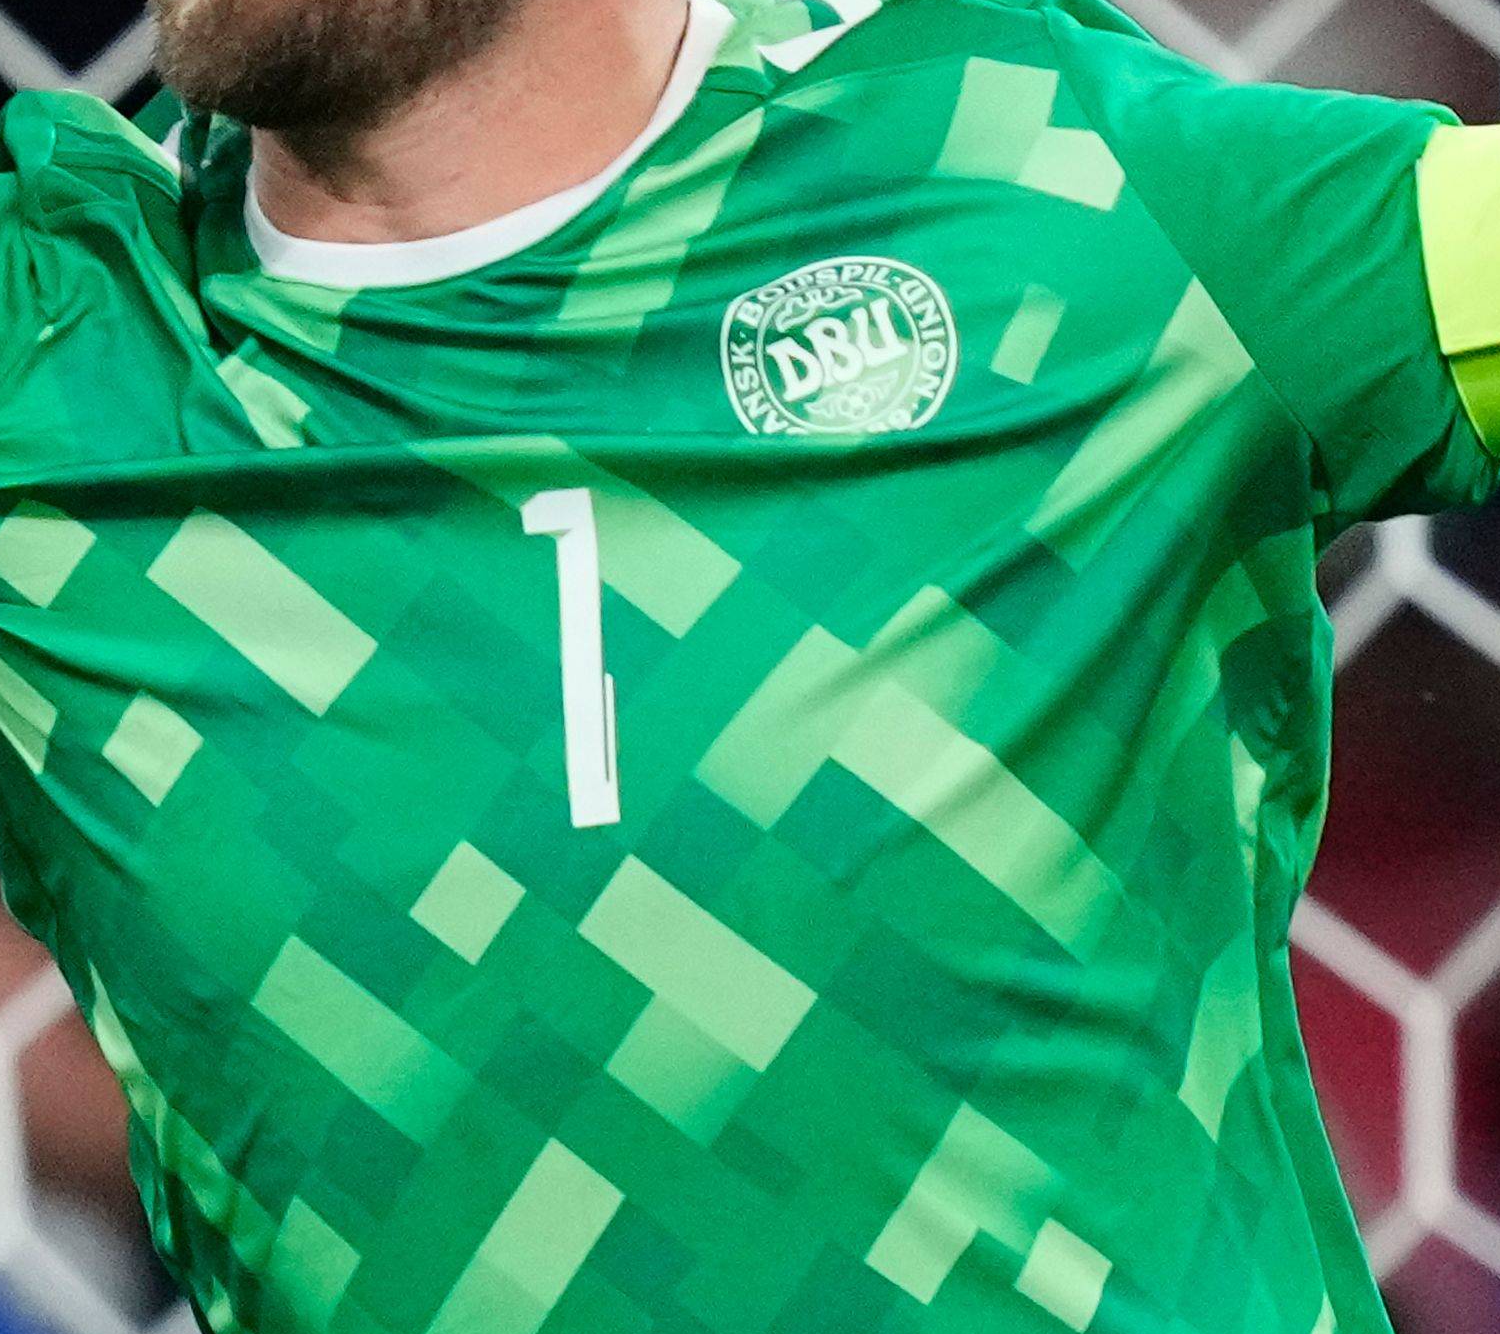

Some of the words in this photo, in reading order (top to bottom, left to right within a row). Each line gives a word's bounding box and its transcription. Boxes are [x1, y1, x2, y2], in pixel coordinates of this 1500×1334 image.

[730, 340, 808, 434] ANSK
[765, 297, 908, 402] DBU
[520, 487, 621, 829] 1
